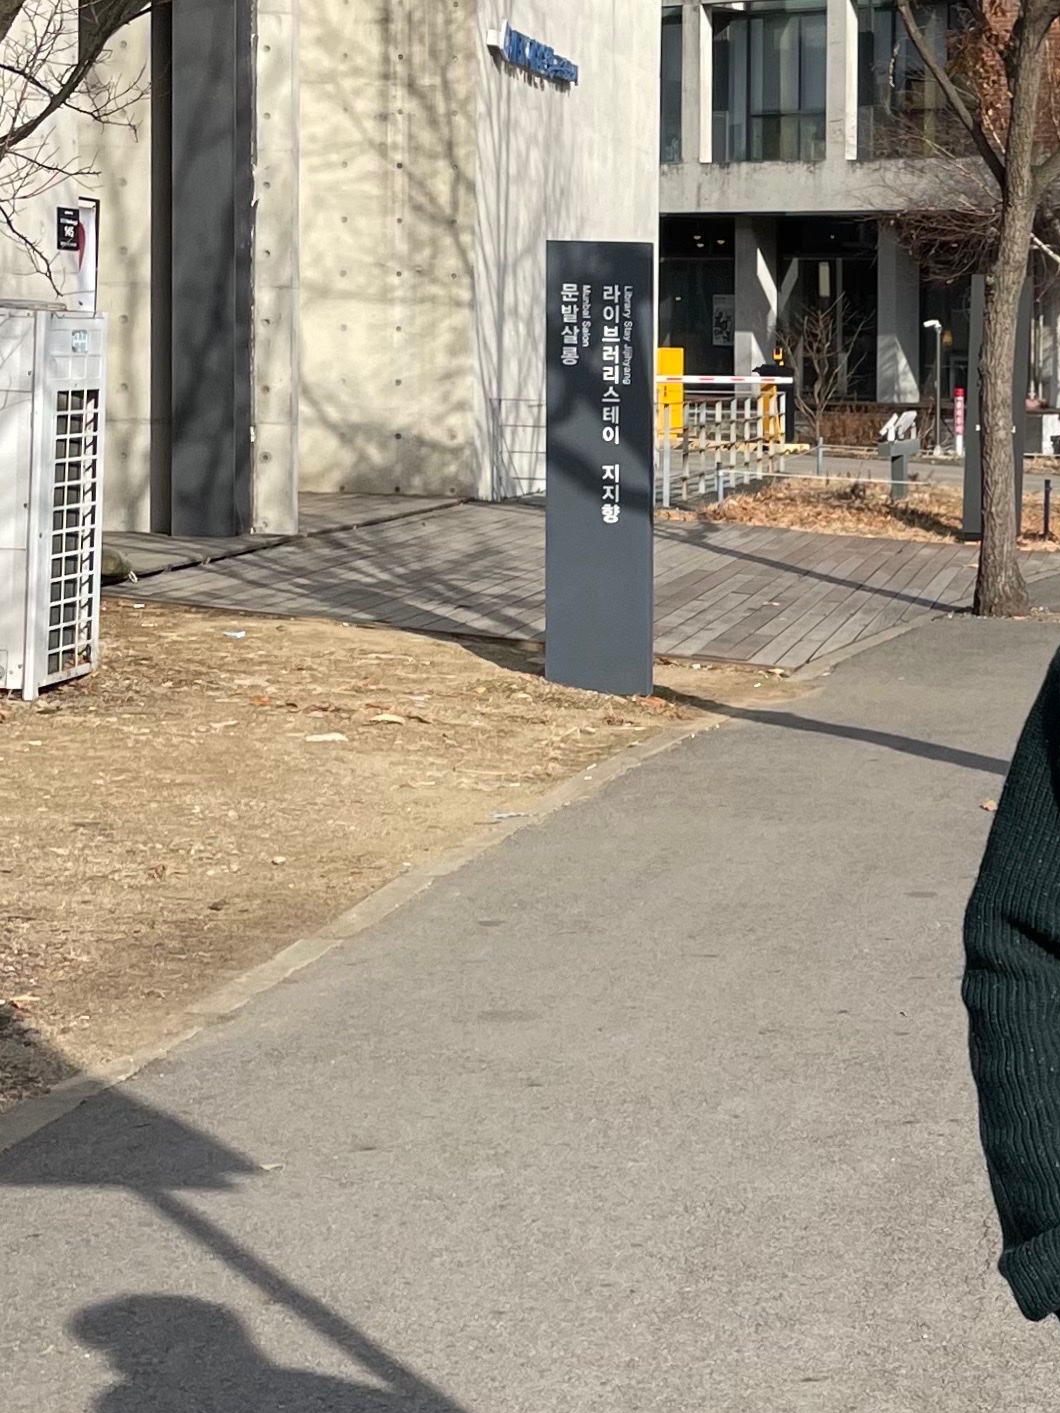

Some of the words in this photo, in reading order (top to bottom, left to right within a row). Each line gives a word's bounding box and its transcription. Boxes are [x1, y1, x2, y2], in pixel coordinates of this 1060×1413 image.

[582, 284, 592, 319] Munbal
[622, 285, 633, 319] Library
[561, 283, 580, 366] 문발살롱
[582, 320, 592, 348] Salon
[622, 320, 633, 342] Stay
[601, 284, 621, 445] 라이브러리스테이
[601, 463, 621, 524] 지지향
